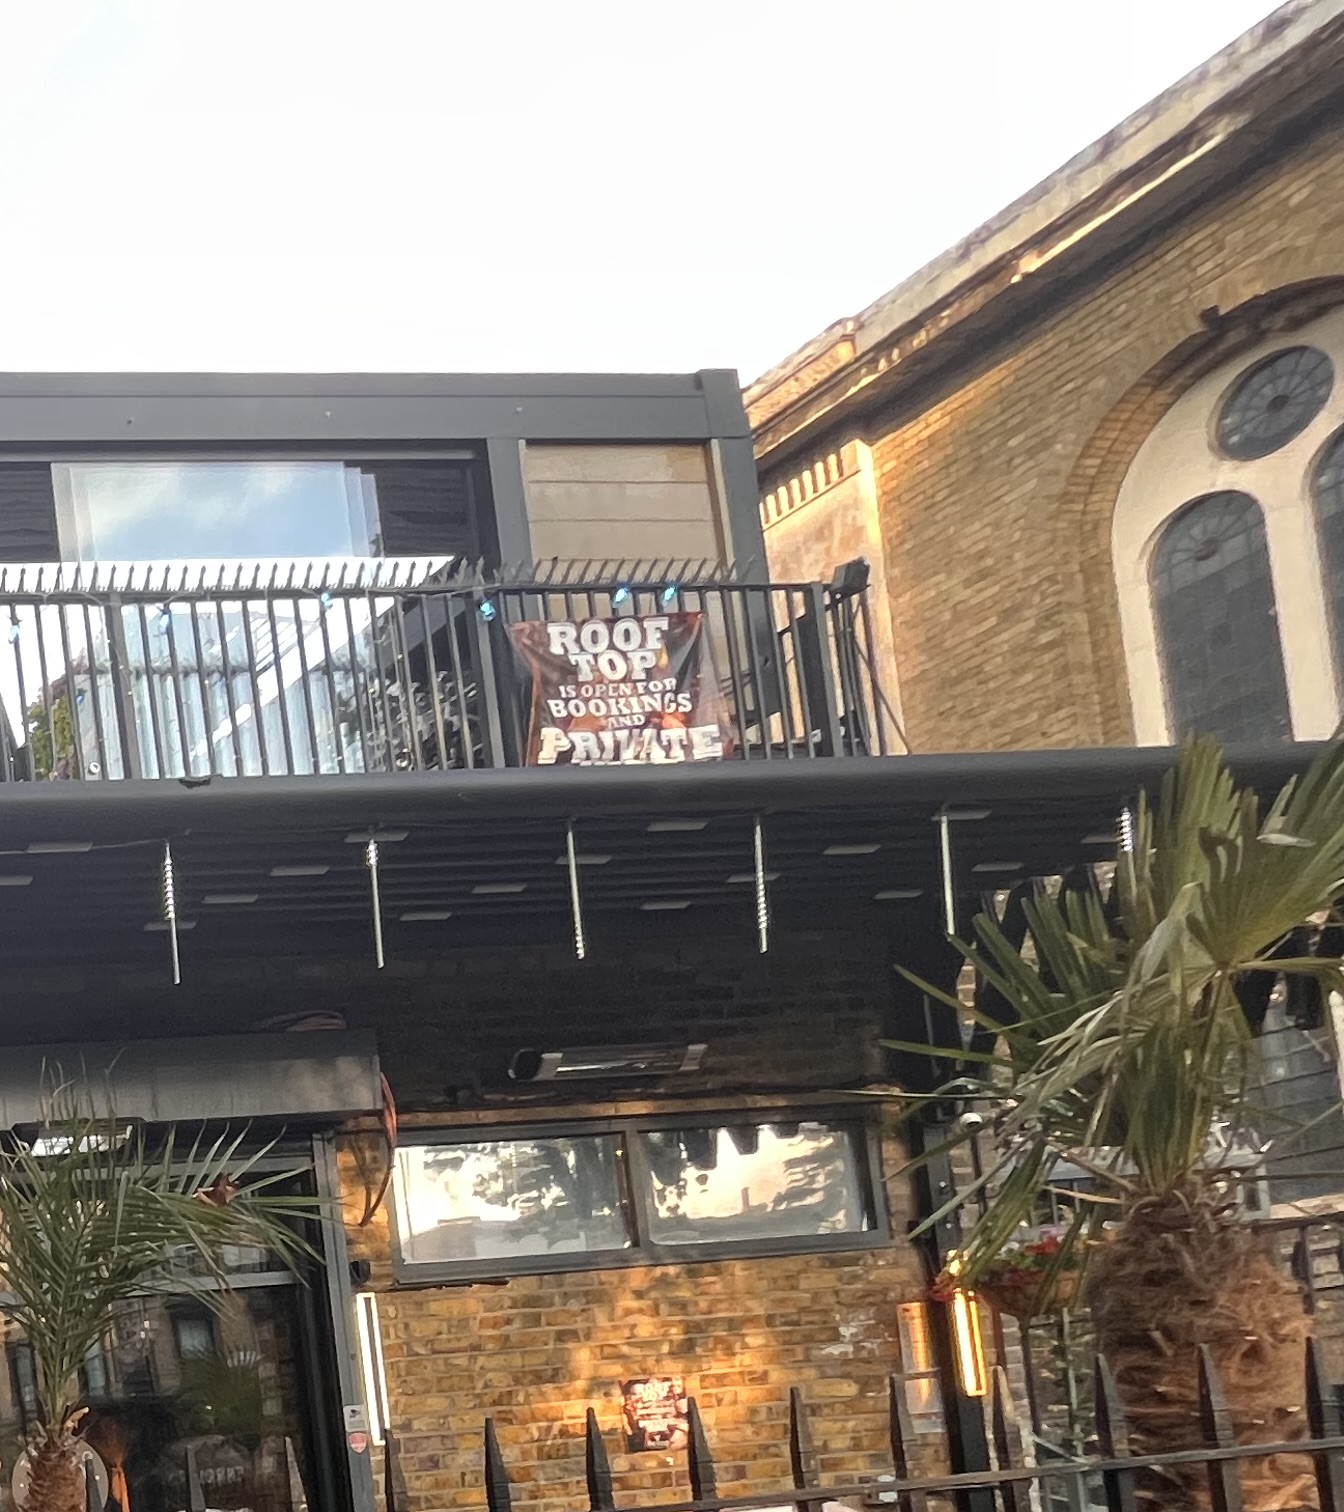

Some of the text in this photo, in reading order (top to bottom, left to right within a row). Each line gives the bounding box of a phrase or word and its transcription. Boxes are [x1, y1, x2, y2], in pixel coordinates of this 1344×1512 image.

[547, 616, 669, 655] ROOF
[568, 649, 657, 681] TOP
[559, 677, 678, 698] IS OPEN FOR
[547, 692, 693, 718] BOOKINGS
[608, 714, 646, 729] AND
[537, 724, 723, 764] PRIVATE
